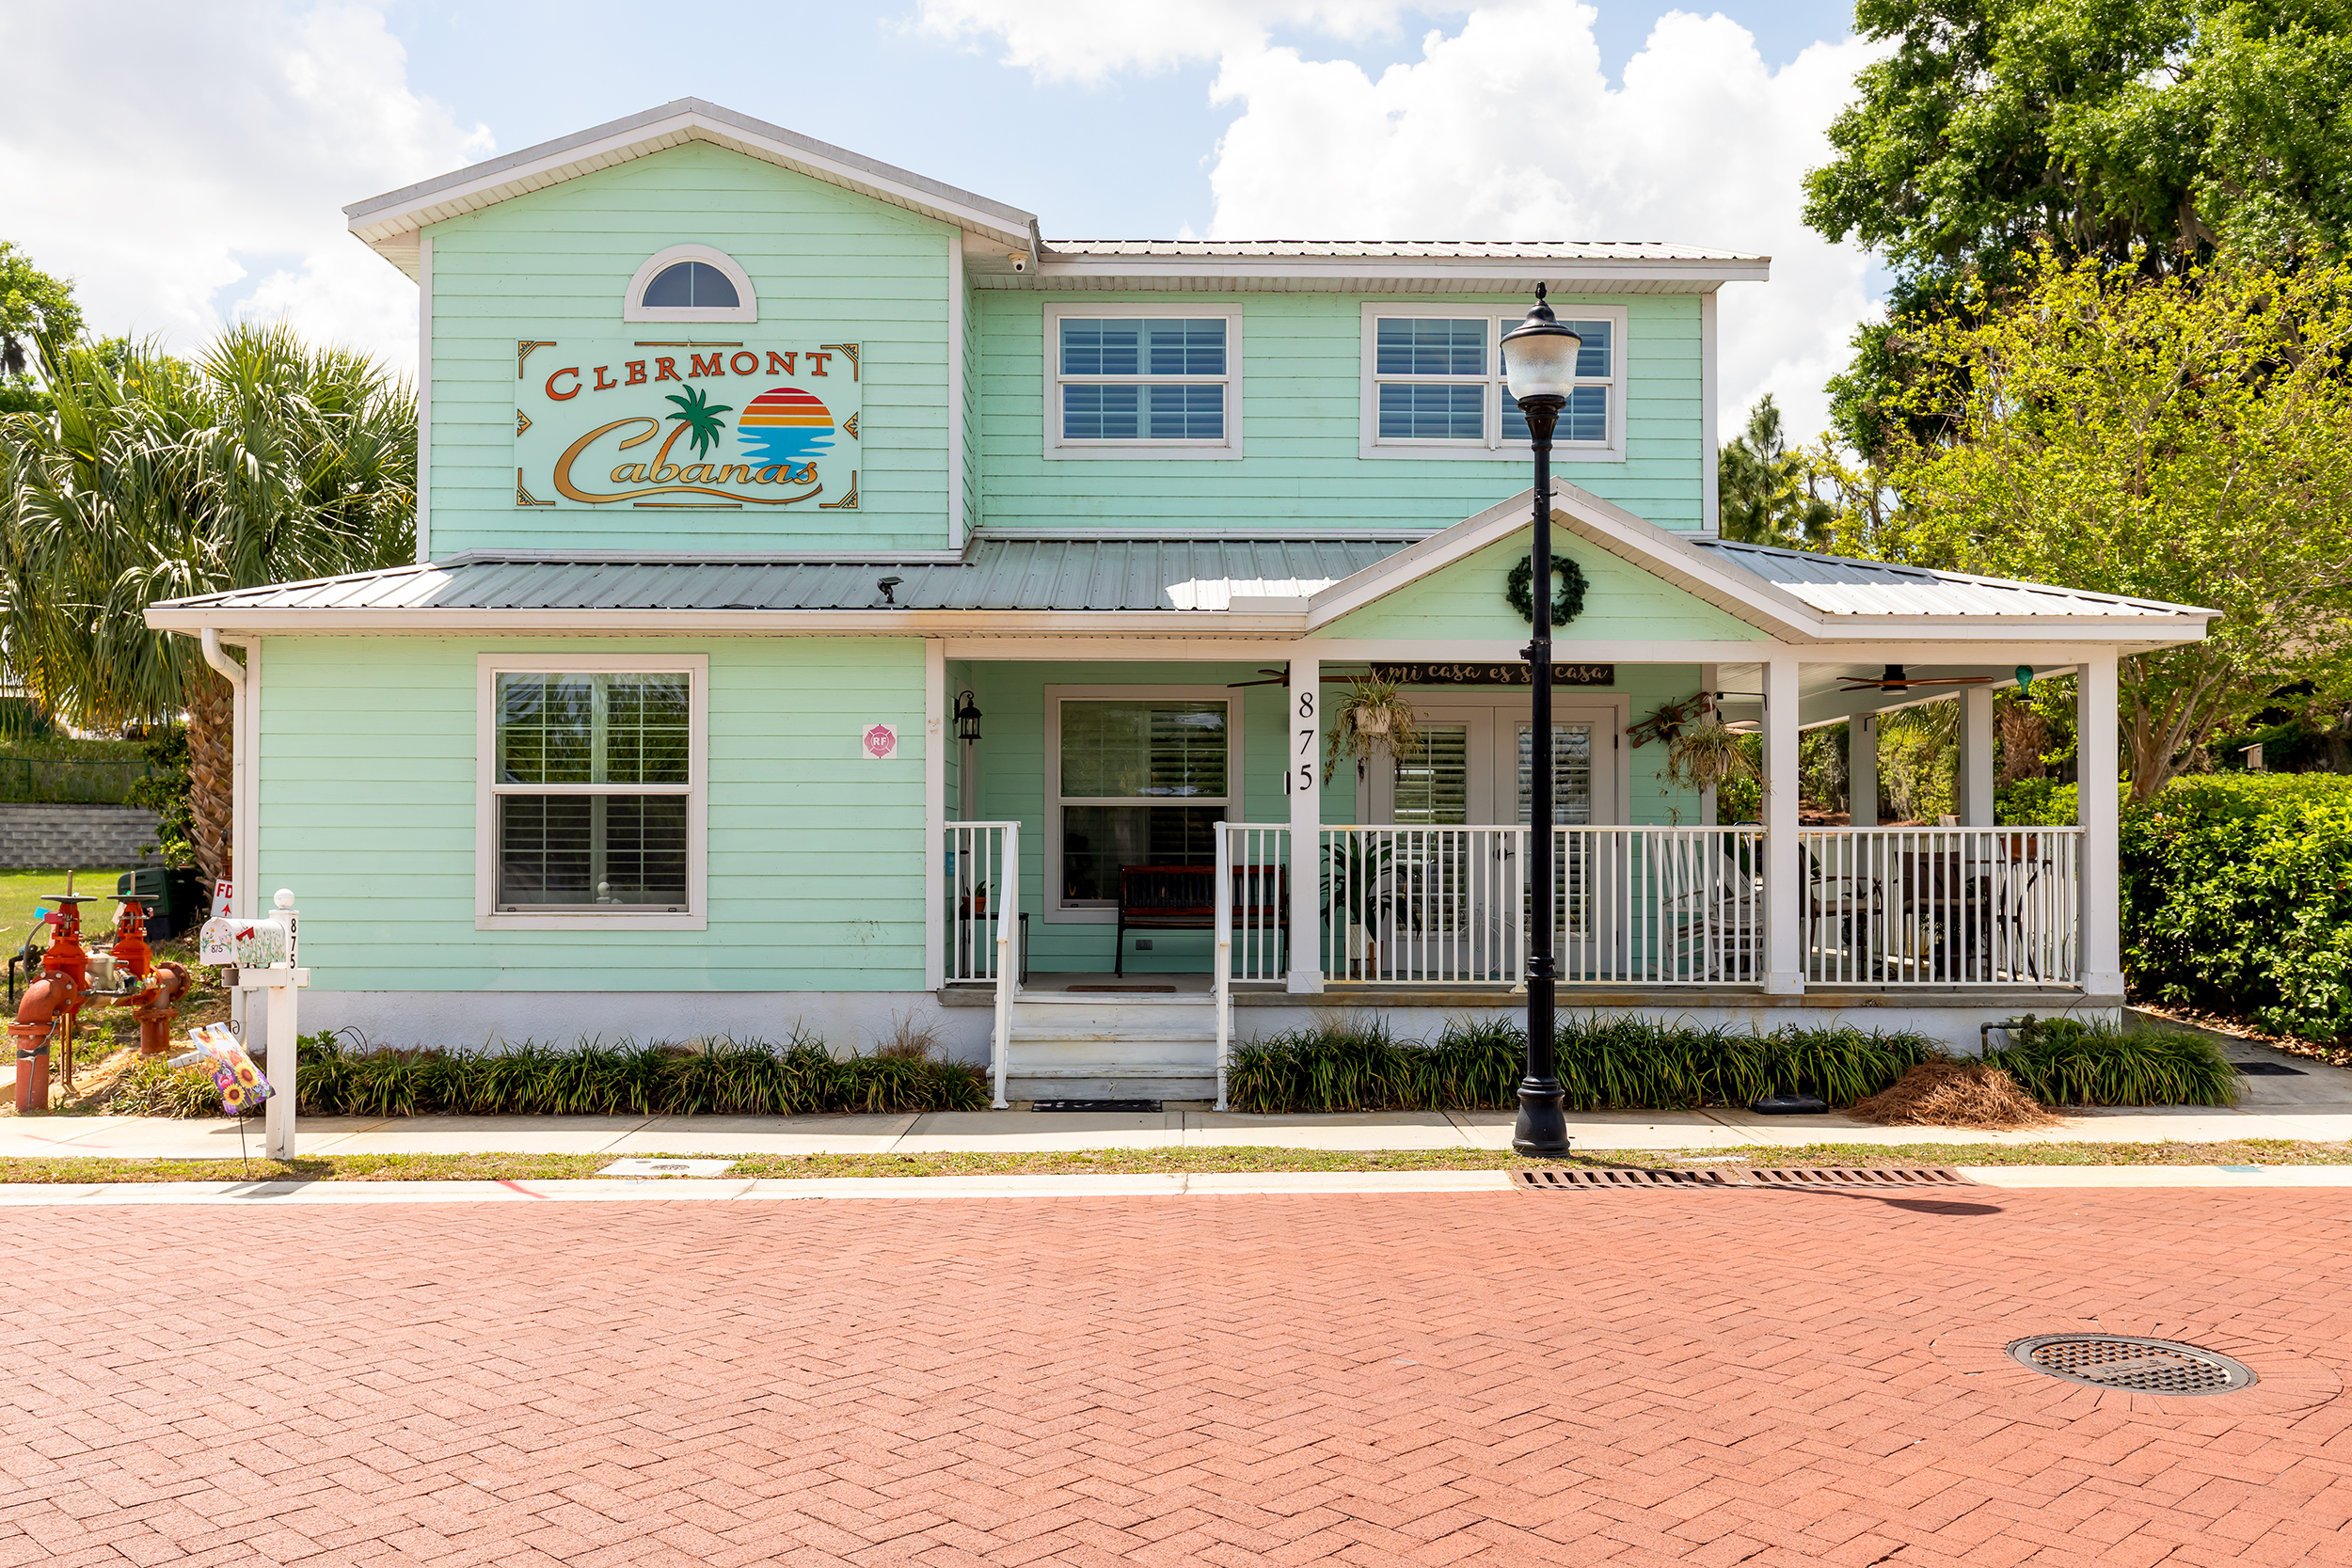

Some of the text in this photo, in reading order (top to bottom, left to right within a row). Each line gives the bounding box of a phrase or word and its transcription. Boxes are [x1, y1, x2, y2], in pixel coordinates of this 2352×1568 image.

[545, 351, 833, 402] CLERMONT
[553, 416, 823, 504] Cabanas
[1389, 664, 1609, 683] mi casa es s casa
[1298, 691, 1315, 791] 875
[211, 944, 224, 954] 875
